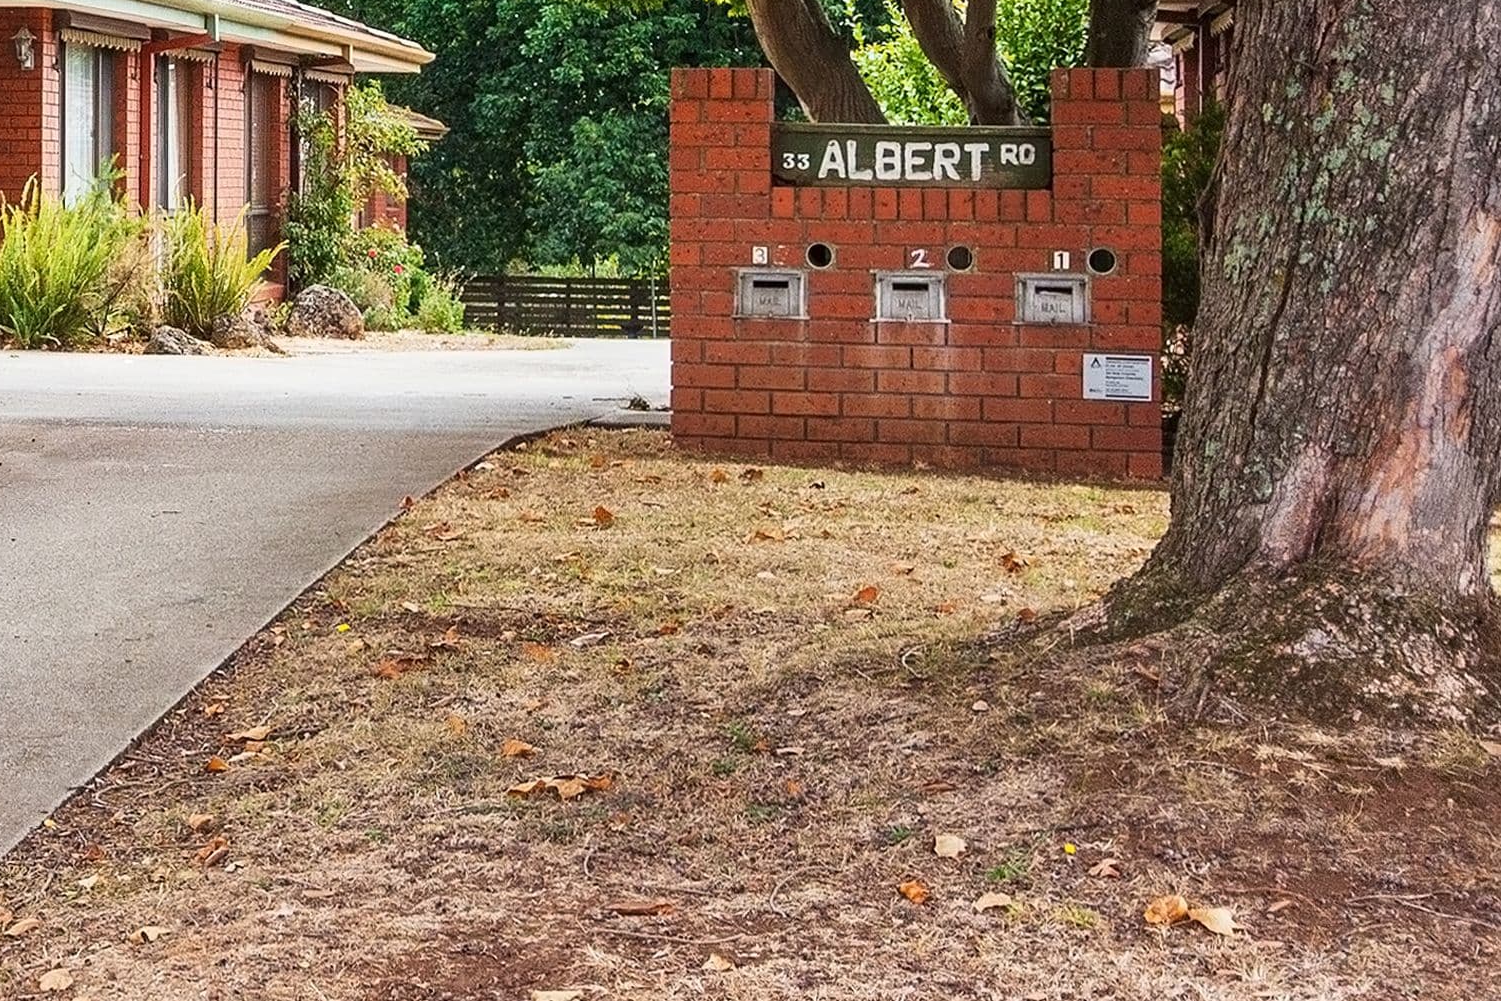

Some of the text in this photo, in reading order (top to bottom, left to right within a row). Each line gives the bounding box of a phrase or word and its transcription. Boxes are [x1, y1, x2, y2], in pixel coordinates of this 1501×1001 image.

[782, 152, 811, 171] 33
[817, 139, 990, 182] ALBERT
[754, 247, 766, 263] 3
[910, 248, 931, 269] 2
[1041, 302, 1067, 313] MAIL
